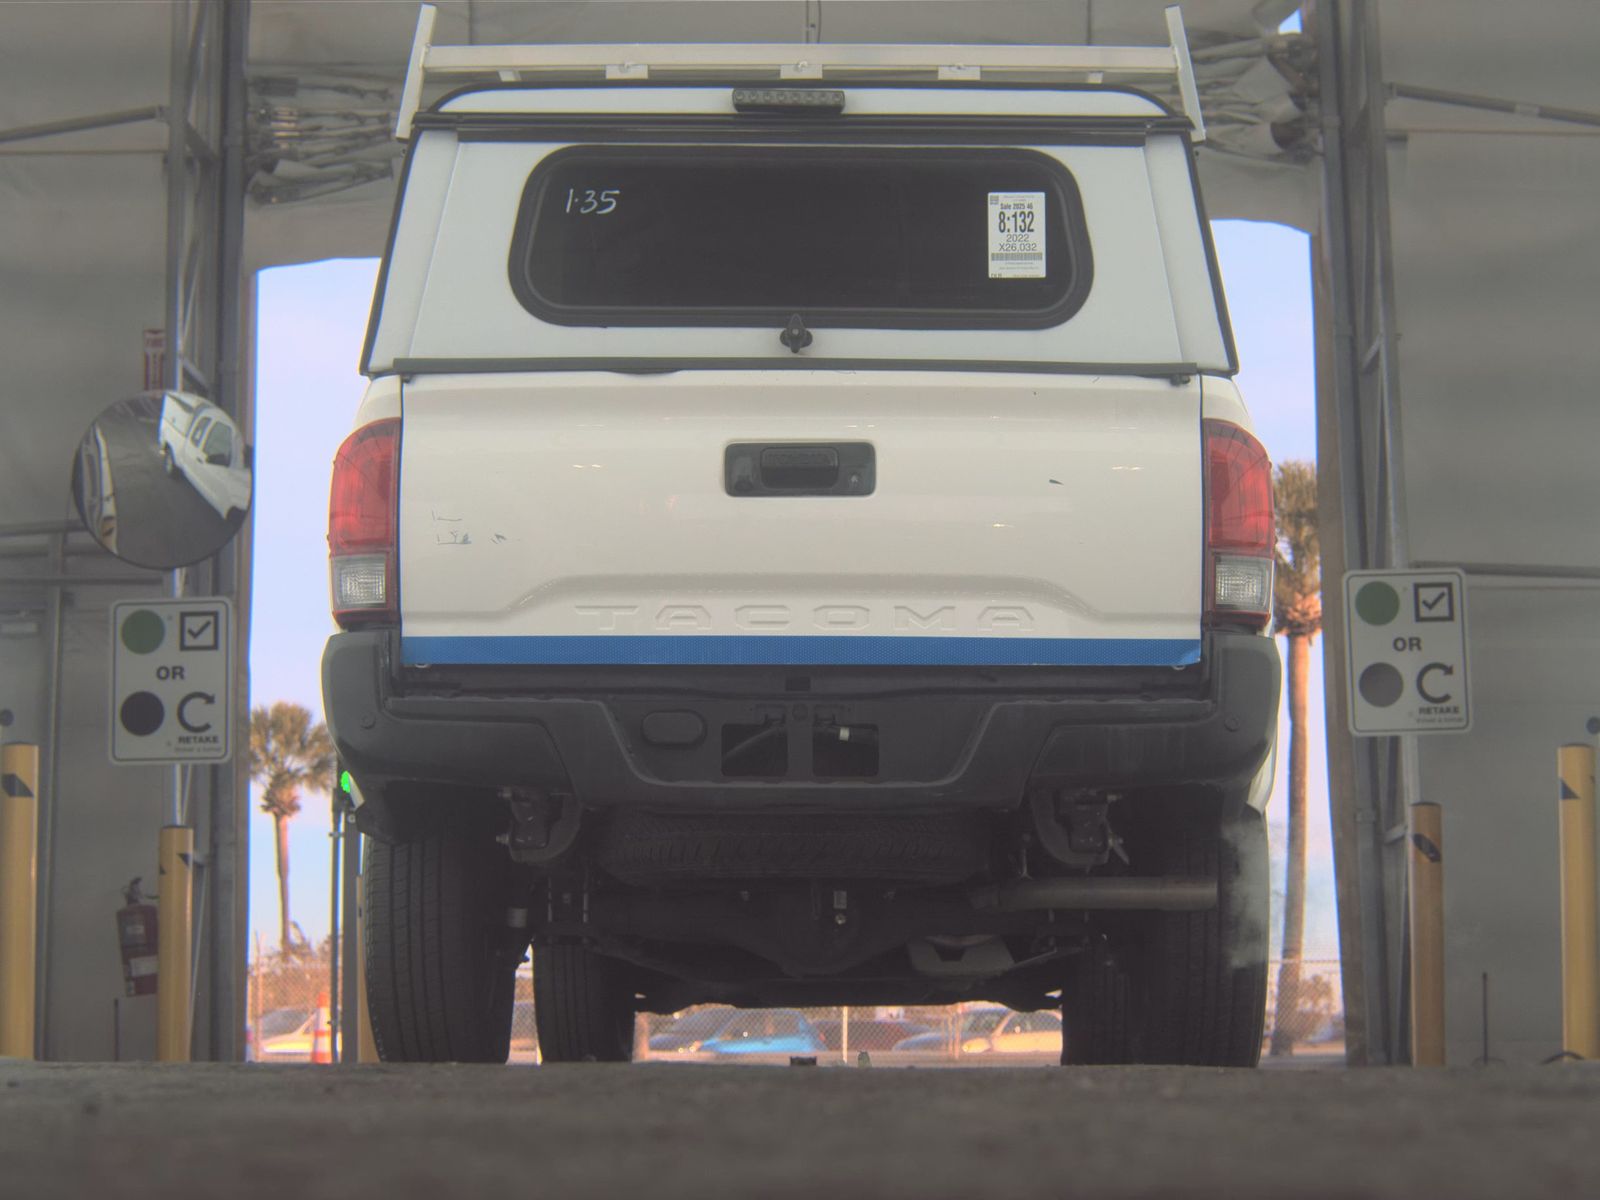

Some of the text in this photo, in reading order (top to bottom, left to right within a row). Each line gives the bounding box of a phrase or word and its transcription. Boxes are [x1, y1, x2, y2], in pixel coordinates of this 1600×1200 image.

[998, 210, 1035, 233] 8:132
[1006, 233, 1030, 242] 2022
[575, 604, 1035, 632] TACOMA
[1392, 636, 1423, 652] OR
[156, 665, 186, 681] OR
[1418, 705, 1460, 716] RETAKE
[178, 735, 220, 745] RETAKE
